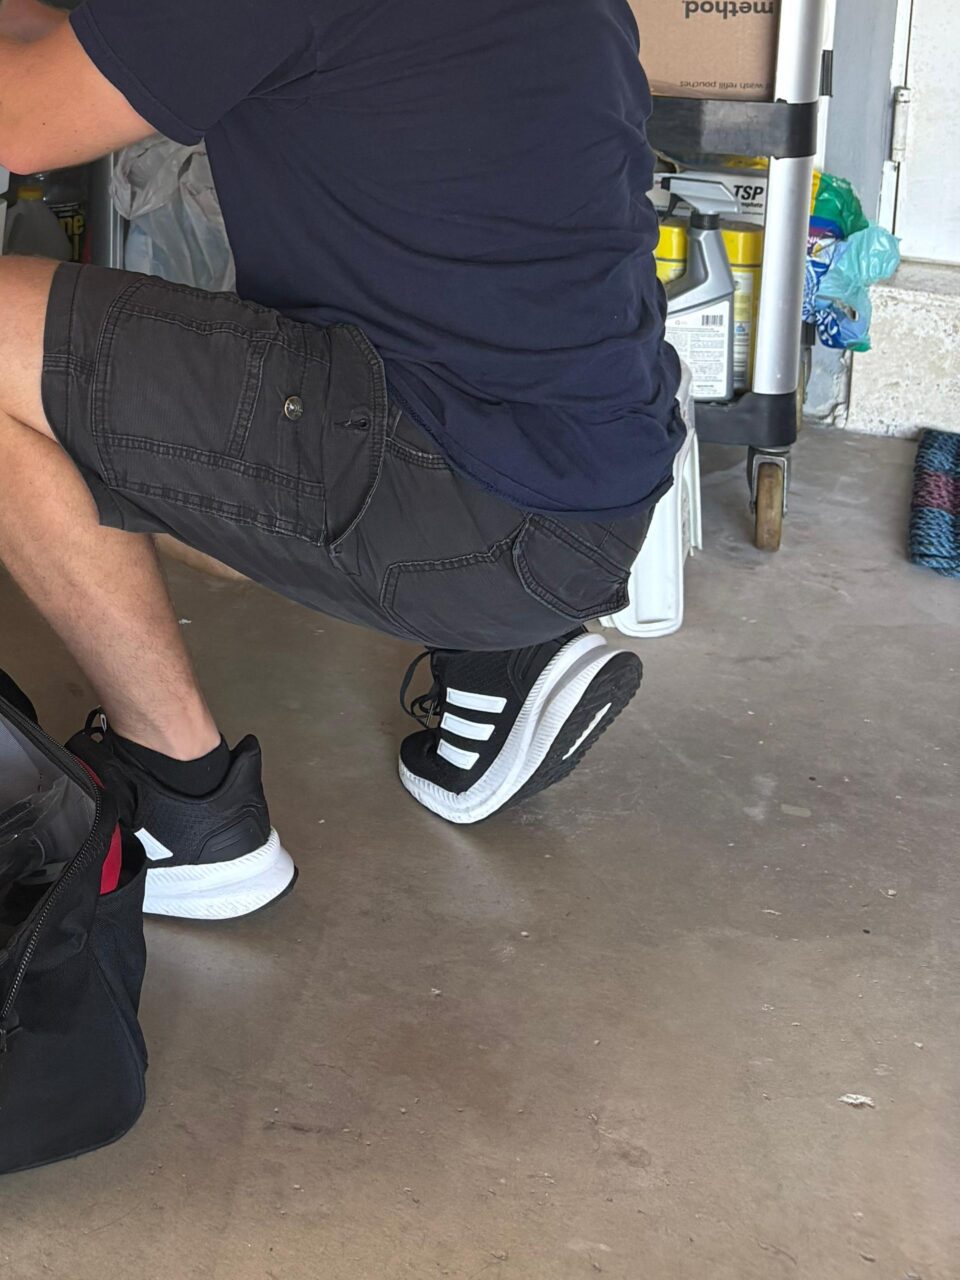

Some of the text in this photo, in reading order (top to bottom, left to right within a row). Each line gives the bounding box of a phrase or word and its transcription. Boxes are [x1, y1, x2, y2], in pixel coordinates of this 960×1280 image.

[679, 80, 717, 89] pouches
[718, 81, 738, 89] refill
[740, 81, 764, 89] wash
[733, 184, 764, 201] TSP
